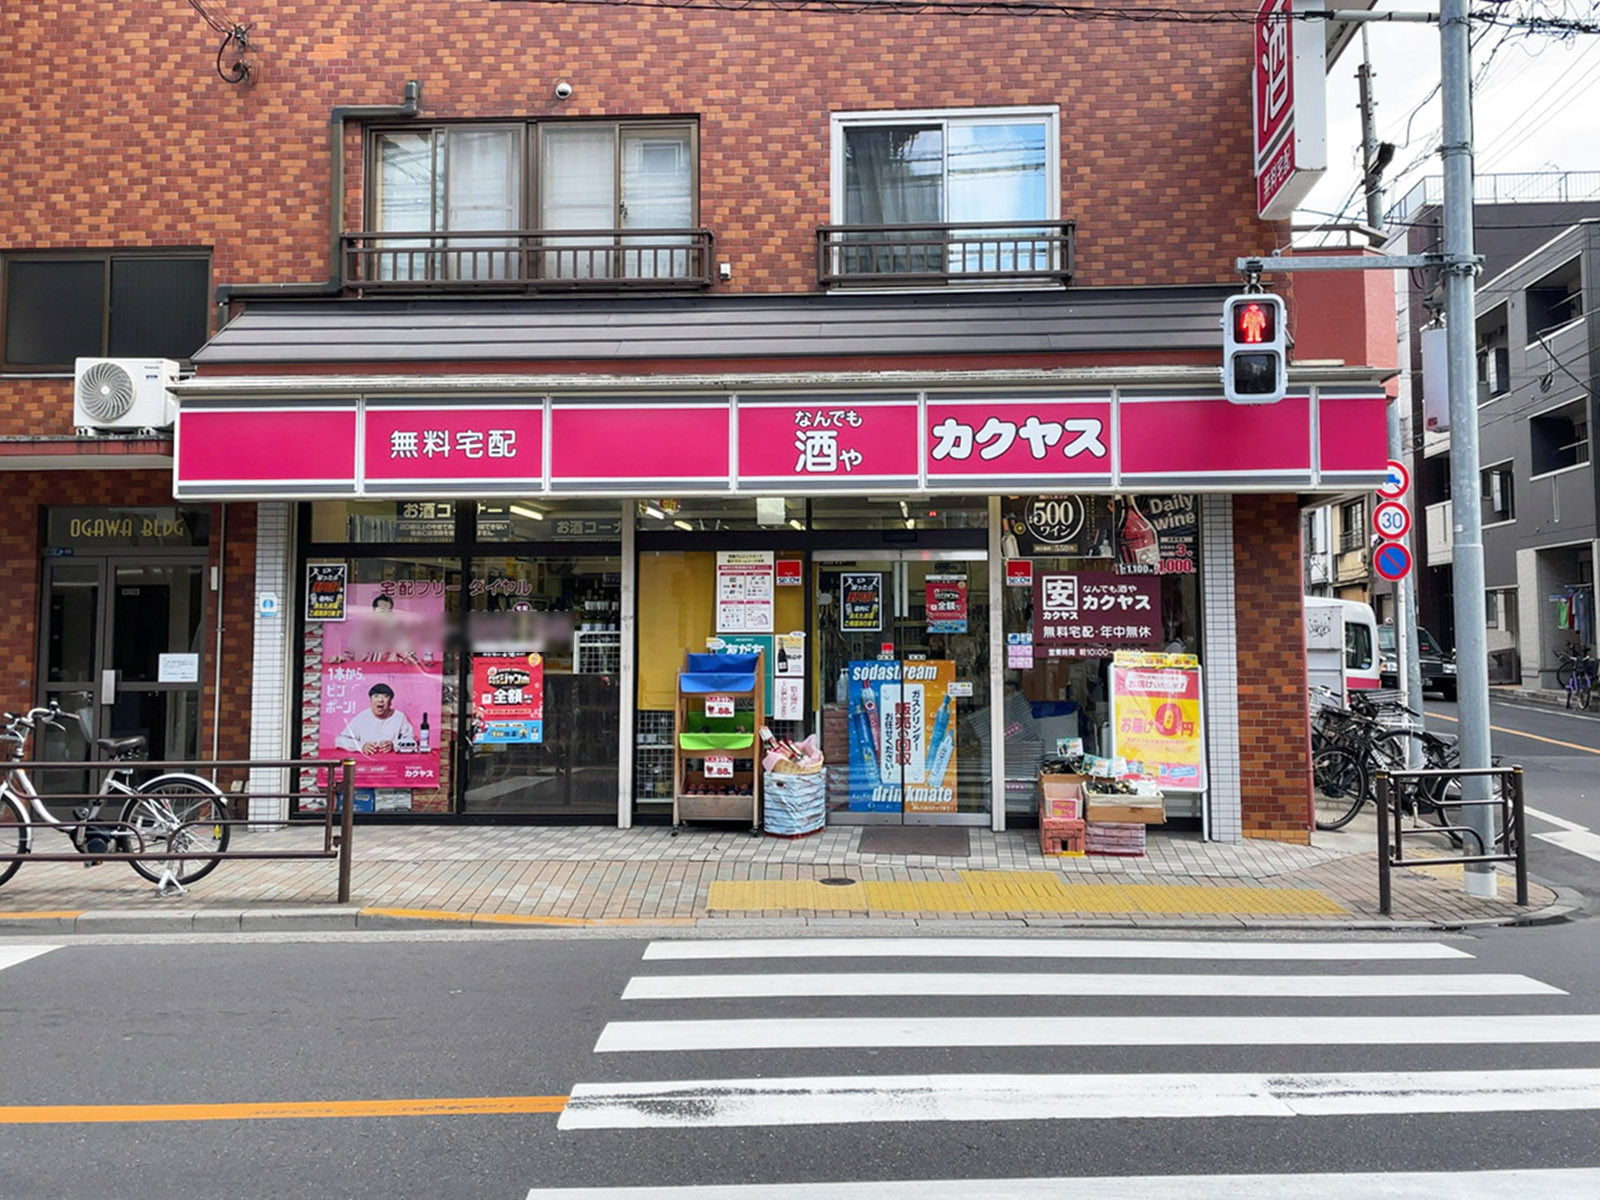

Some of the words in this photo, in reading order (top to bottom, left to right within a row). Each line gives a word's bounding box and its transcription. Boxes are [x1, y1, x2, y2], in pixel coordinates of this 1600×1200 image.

[1261, 12, 1288, 134] 酒
[794, 410, 863, 427] なんでも
[390, 429, 517, 459] 無料宅配
[932, 417, 1107, 460] カクヤス
[794, 429, 863, 472] 酒や
[1033, 501, 1074, 526] 500
[1149, 495, 1195, 516] Daily
[71, 519, 132, 538] OGAWA
[140, 518, 184, 538] BLDG
[1153, 512, 1195, 532] wine
[1382, 512, 1402, 529] 30
[1040, 526, 1071, 537] ワイン
[1083, 585, 1137, 594] なんでも酒や
[1083, 595, 1151, 610] カクヤス
[1043, 611, 1078, 620] カクヤス
[852, 665, 937, 682] sodastream
[326, 683, 346, 698] ピン
[493, 688, 523, 704] 全額
[325, 701, 356, 714] ポーン!
[405, 769, 434, 778] カクヤス
[872, 786, 952, 803] drinkmate
